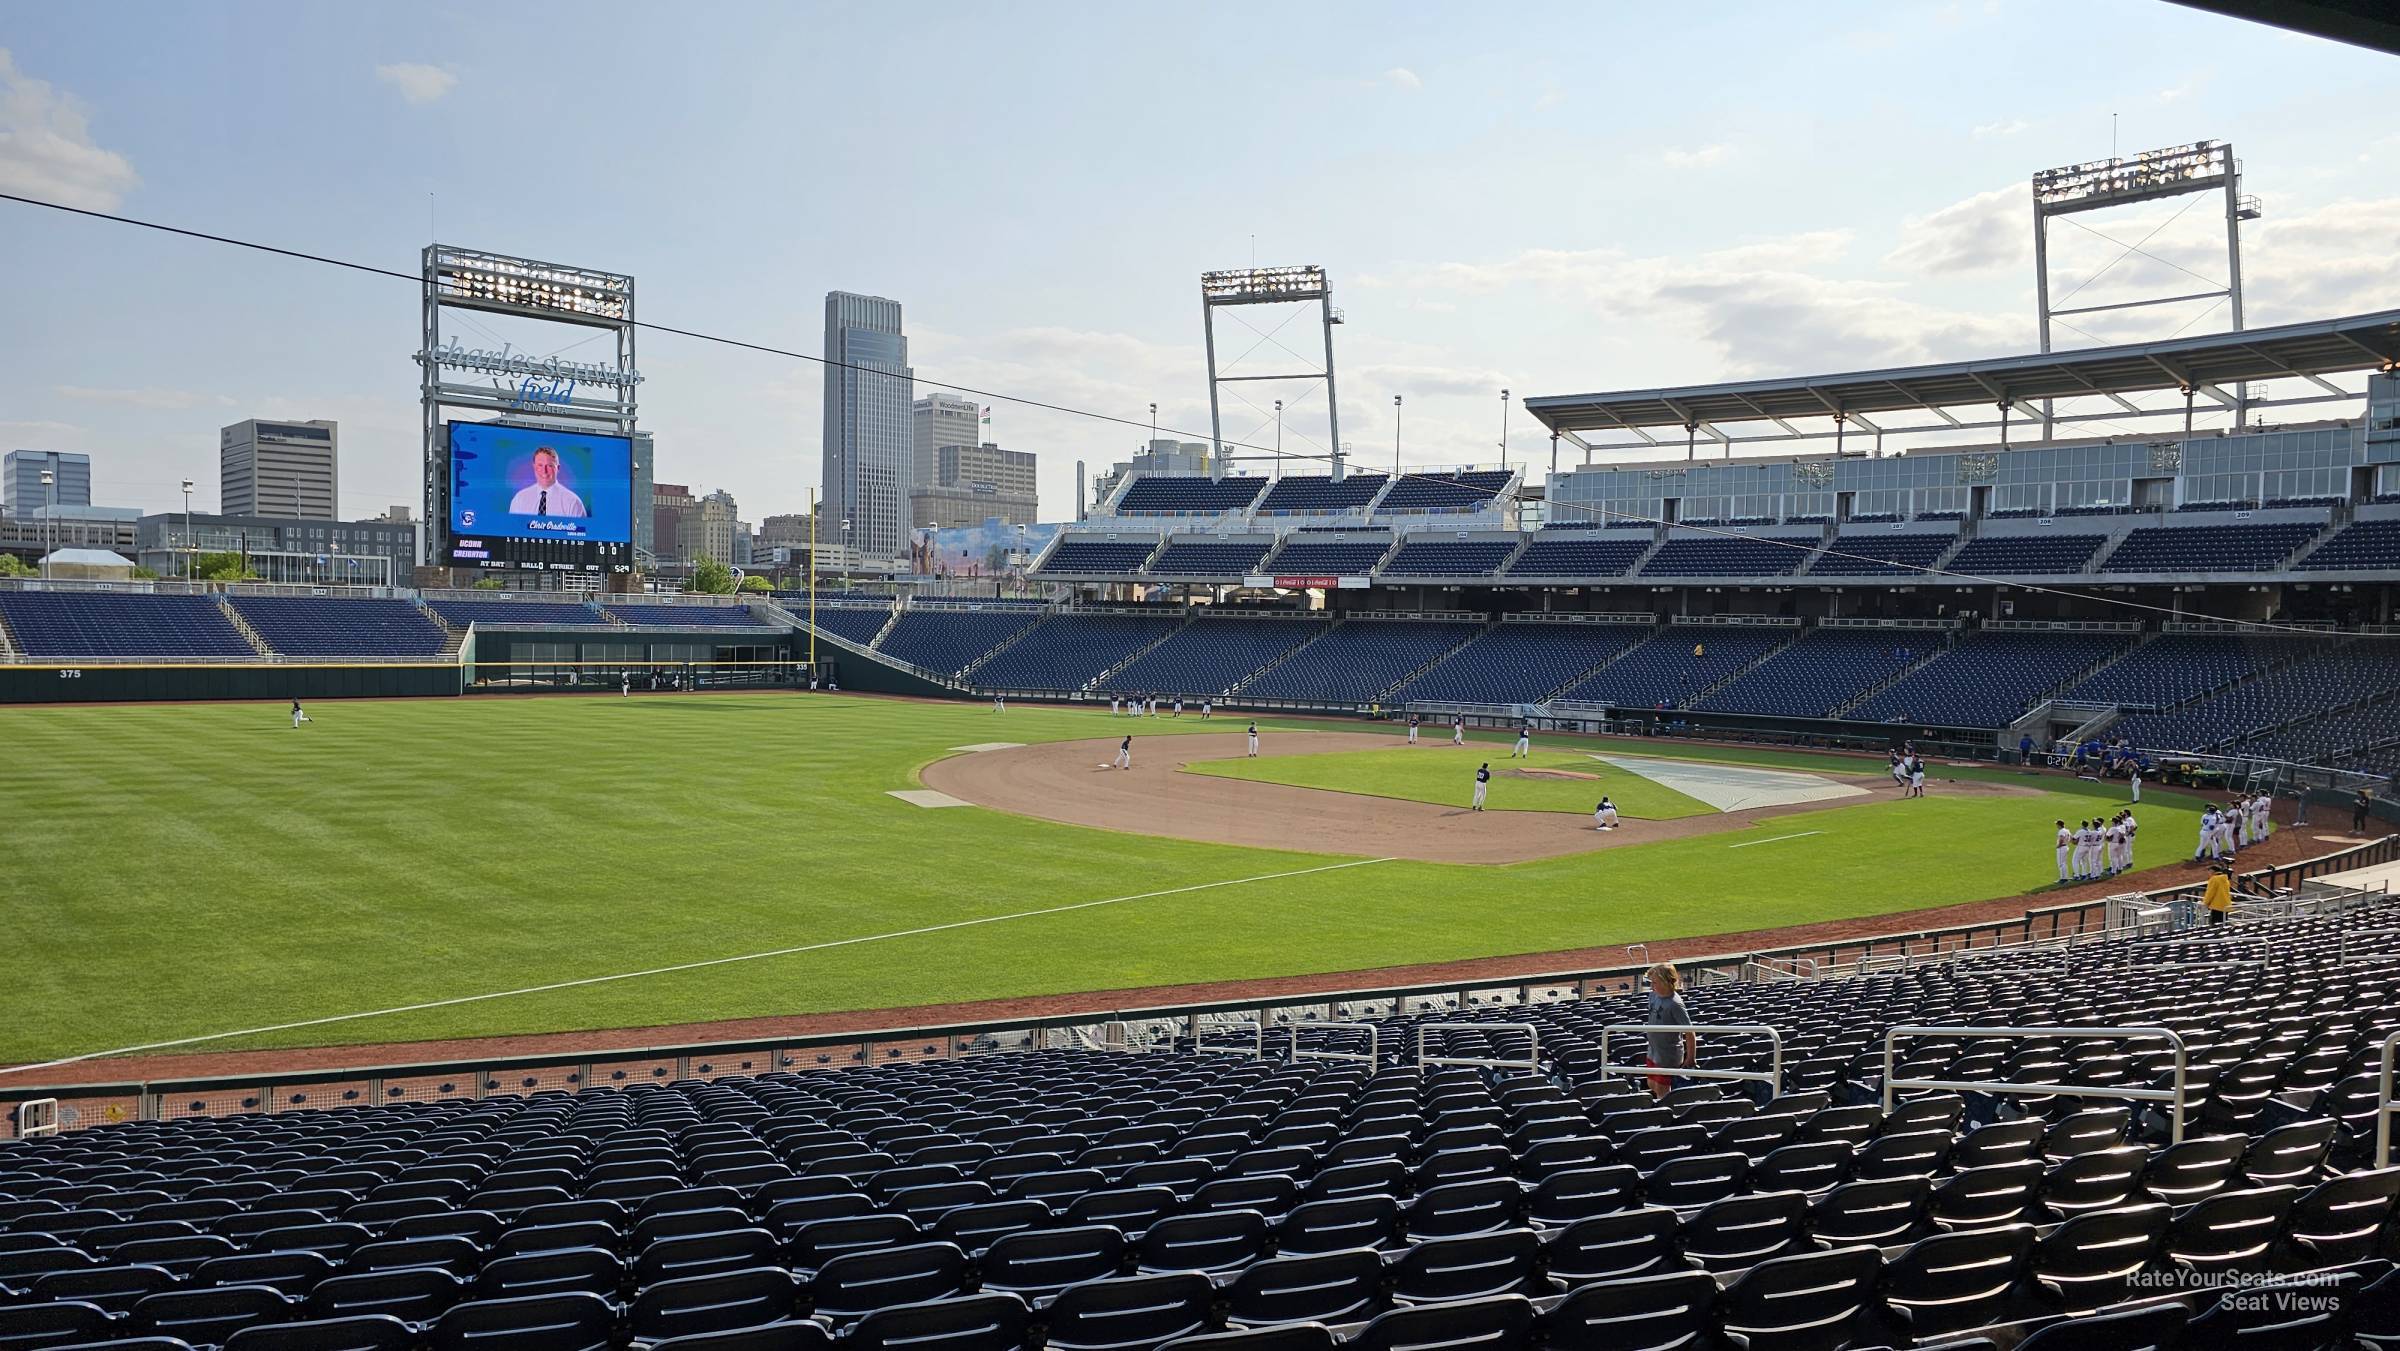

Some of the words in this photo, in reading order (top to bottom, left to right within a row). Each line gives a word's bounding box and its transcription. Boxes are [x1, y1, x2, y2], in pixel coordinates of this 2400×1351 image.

[430, 335, 537, 374] charles
[543, 356, 641, 386] SCHWAB
[510, 376, 576, 408] field
[523, 402, 568, 415] OMAHA
[453, 550, 489, 558] CREIGHTON
[459, 540, 483, 548] UCONN
[600, 546, 605, 555] 0
[612, 546, 617, 555] 0
[615, 565, 629, 573] 5:29
[60, 670, 81, 678] 375
